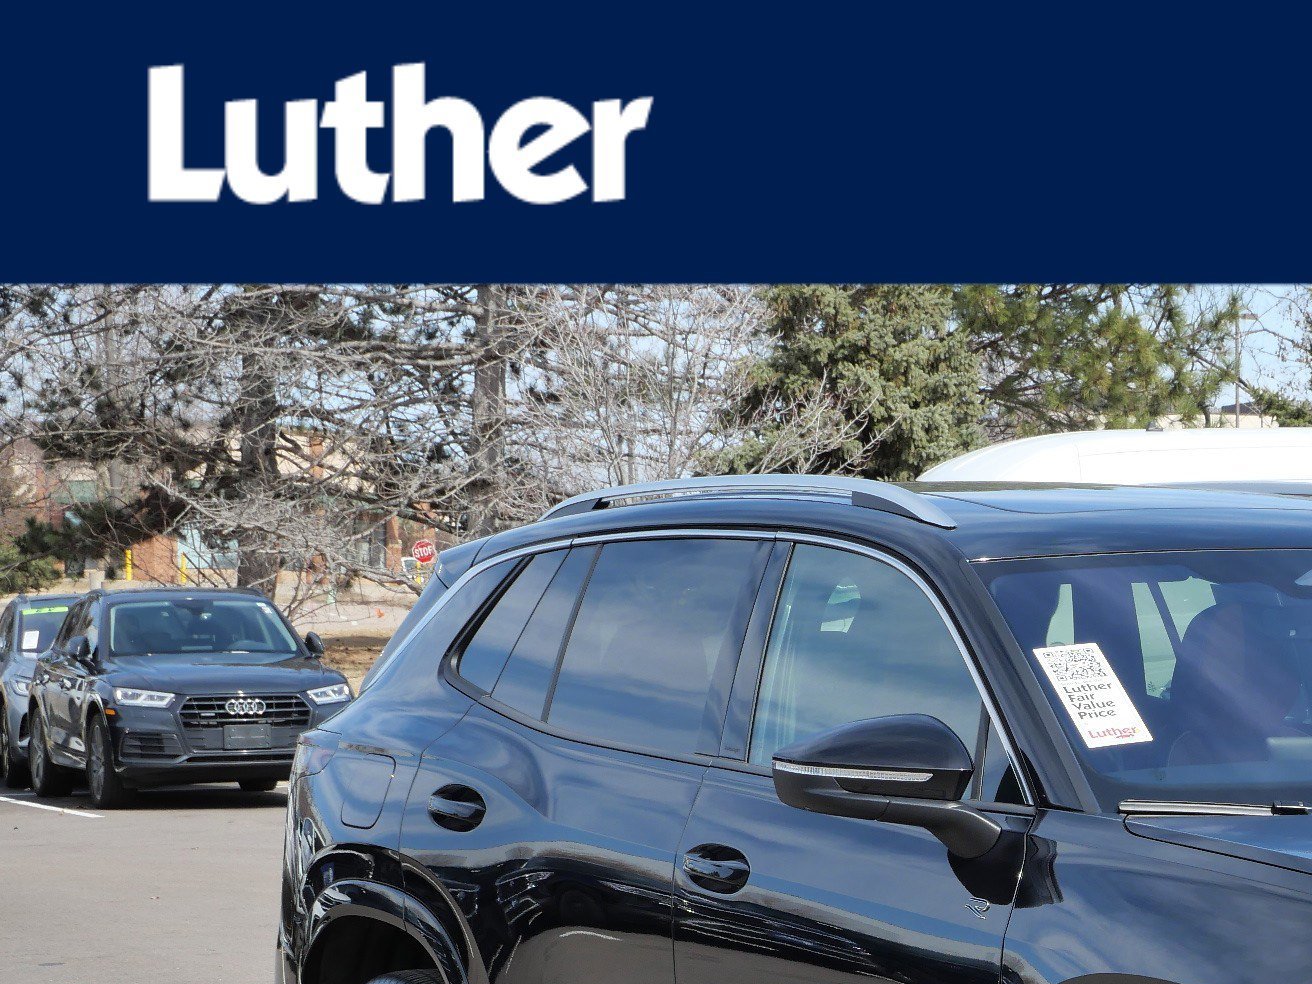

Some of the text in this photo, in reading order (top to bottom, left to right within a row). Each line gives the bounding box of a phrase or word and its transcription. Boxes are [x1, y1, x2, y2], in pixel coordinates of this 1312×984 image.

[415, 546, 433, 558] STOP
[1062, 682, 1113, 694] Luther
[1067, 693, 1095, 703] Fair
[1071, 700, 1116, 711] Value
[1077, 709, 1117, 720] Price
[1087, 726, 1138, 739] Luther
